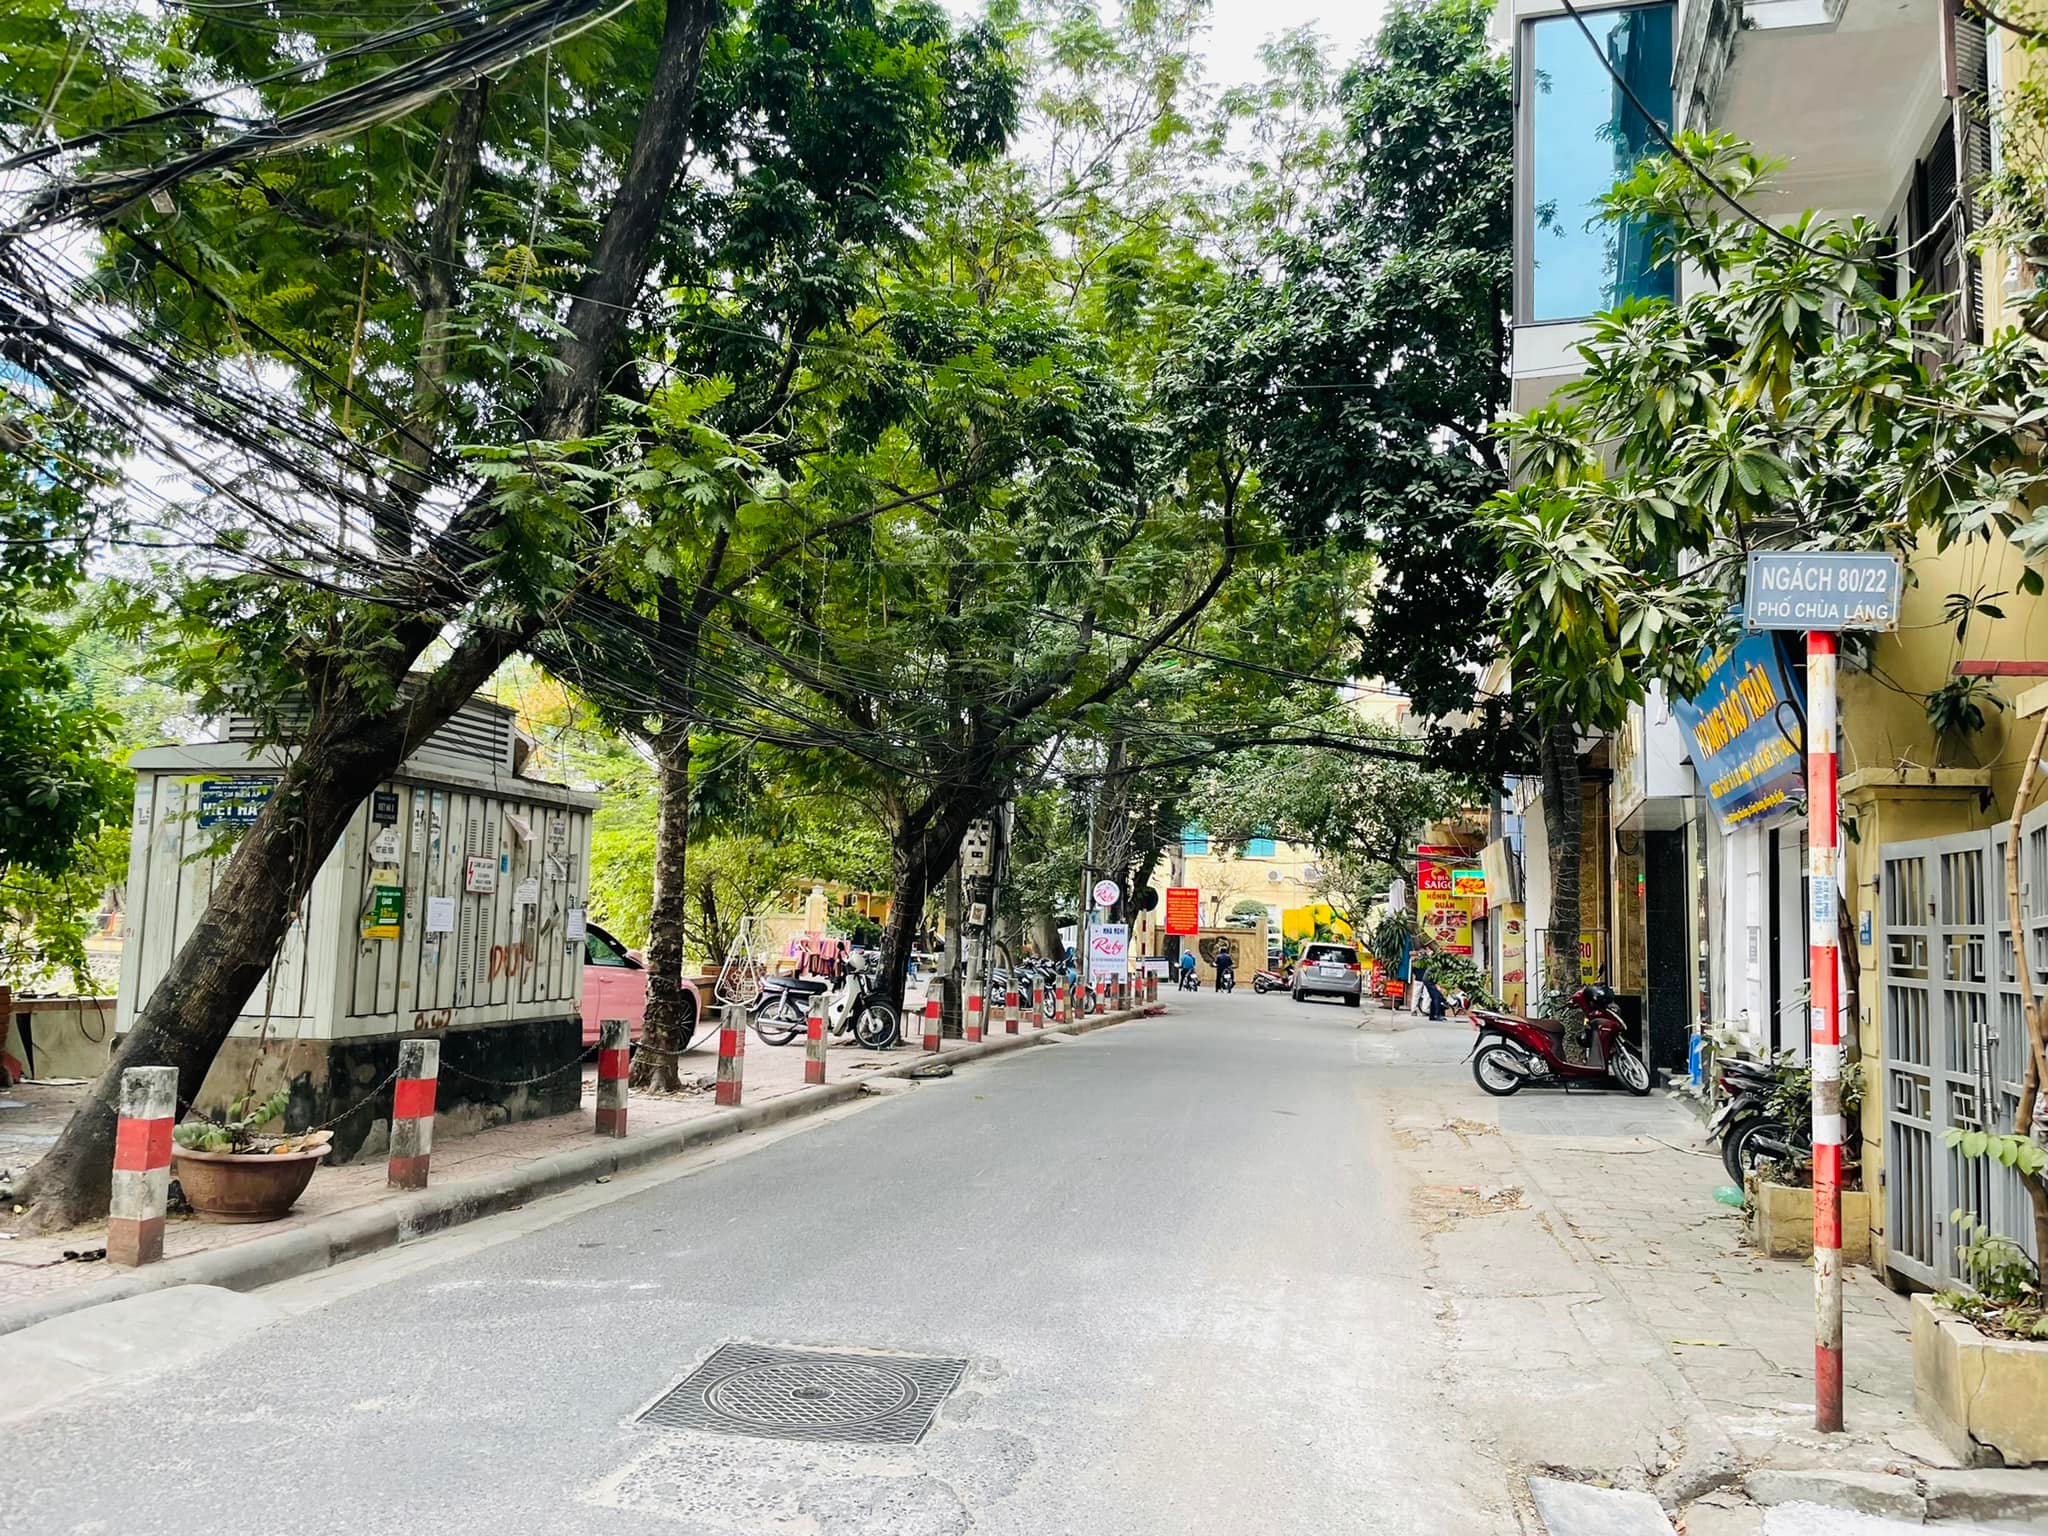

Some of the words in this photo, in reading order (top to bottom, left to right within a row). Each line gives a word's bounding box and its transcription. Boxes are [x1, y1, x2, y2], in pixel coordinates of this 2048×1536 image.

[1761, 562, 1832, 592] NGÁCH
[1838, 568, 1887, 593] 80/22
[1757, 596, 1792, 617] PHỐ
[1795, 599, 1839, 619] CHÙA
[1844, 600, 1889, 620] LÁNG
[1092, 937, 1124, 955] Ruby
